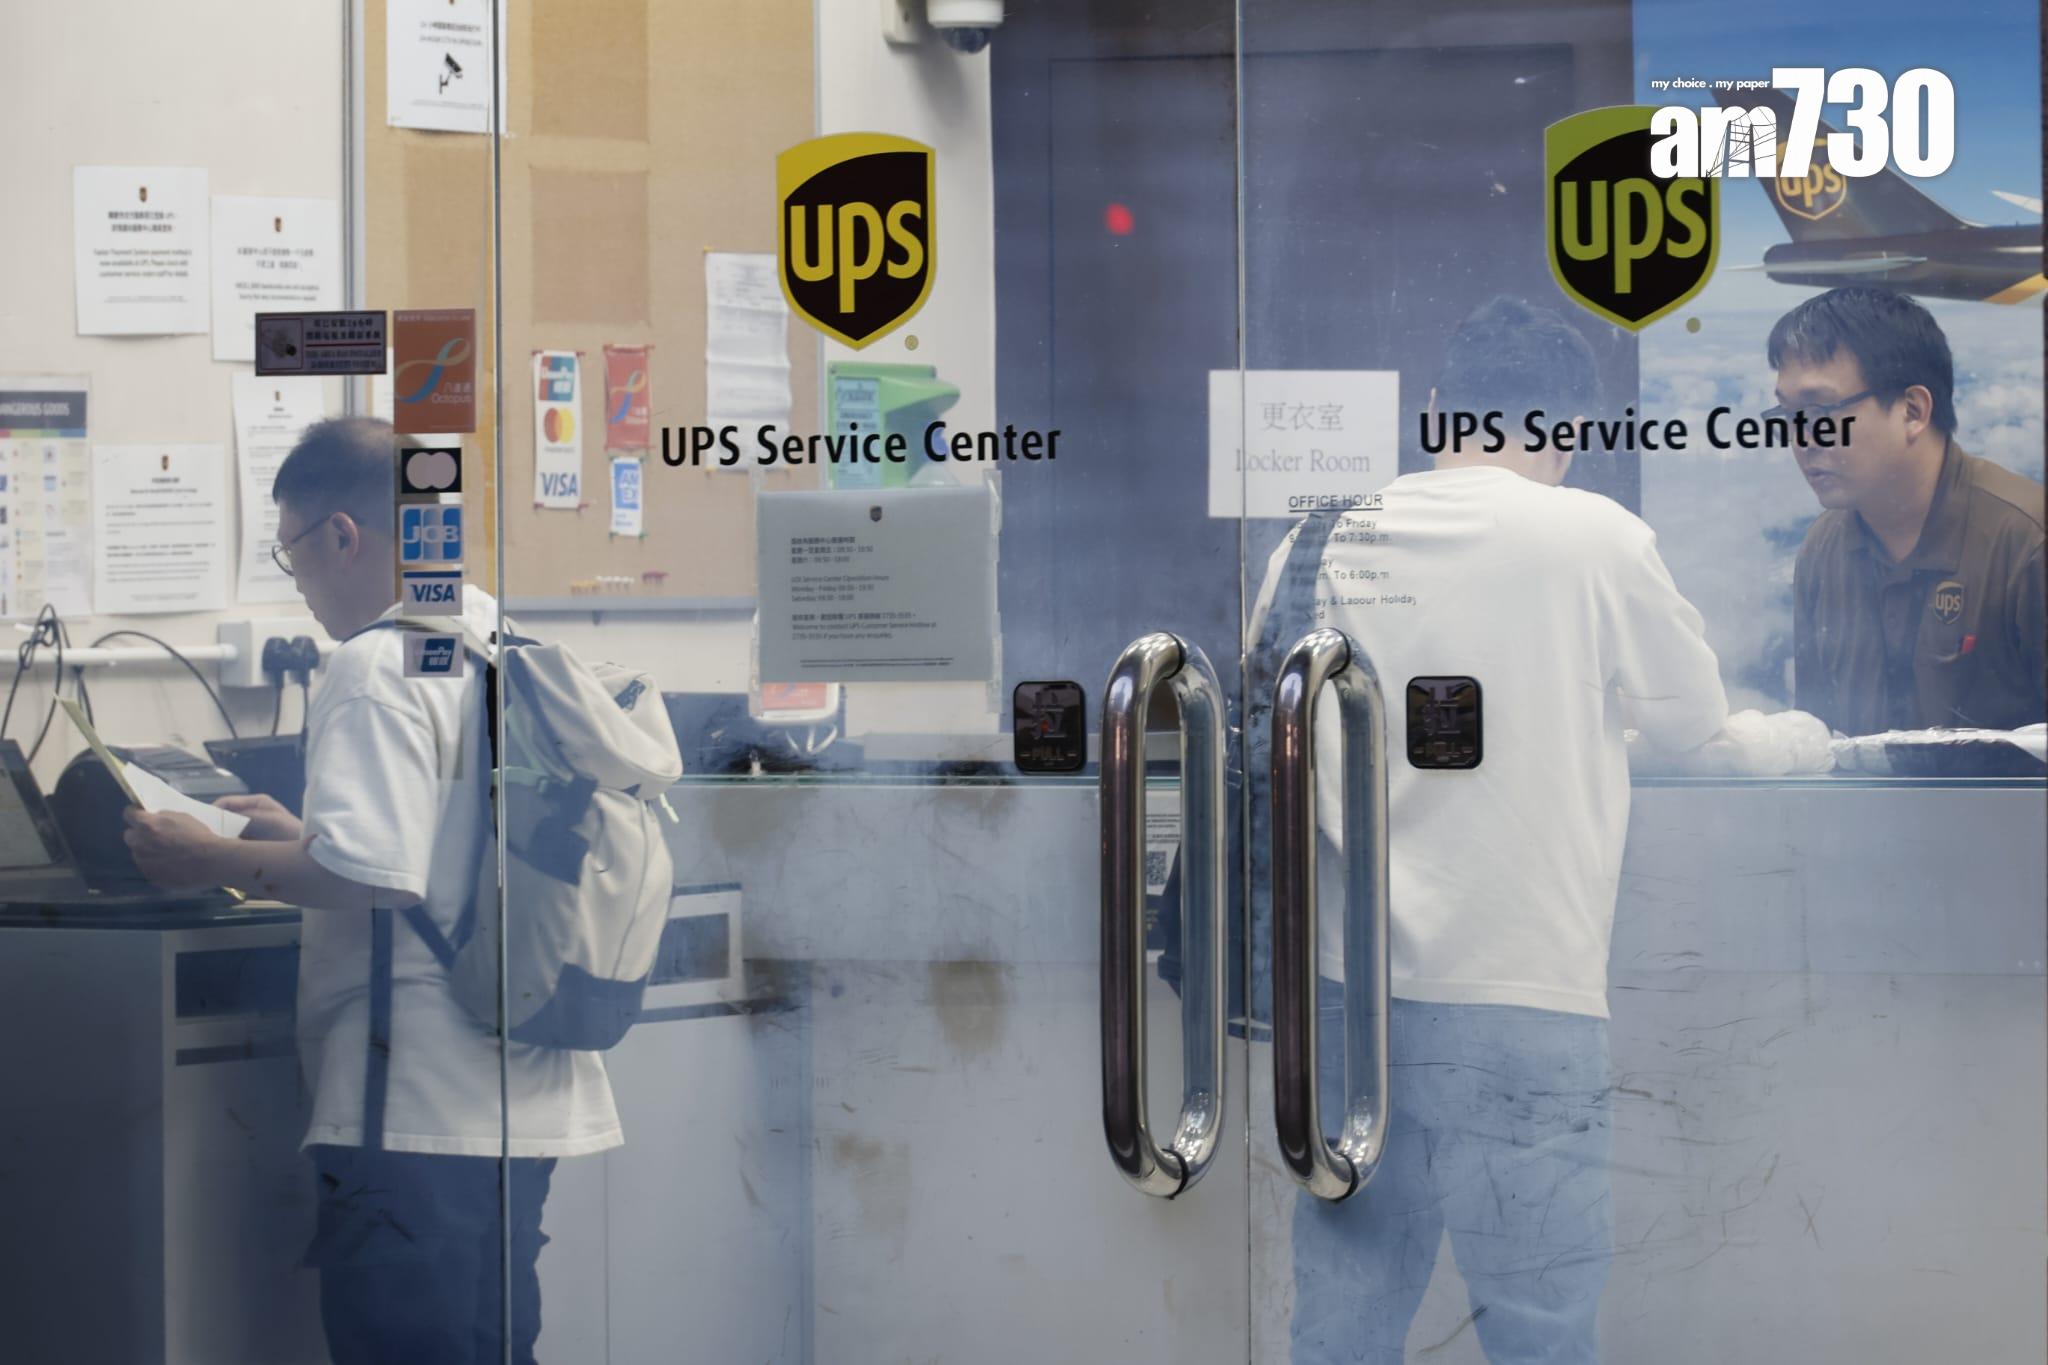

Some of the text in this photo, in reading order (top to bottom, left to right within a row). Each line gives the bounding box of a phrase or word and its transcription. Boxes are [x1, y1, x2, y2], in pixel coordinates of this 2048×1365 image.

[1781, 162, 1843, 208] ups
[1561, 178, 1707, 294] ups
[791, 200, 924, 313] ups
[1261, 401, 1344, 431] 更衣室
[1420, 406, 1856, 454] UPS Service Center
[661, 421, 1062, 467] UPS Service Center
[1235, 449, 1371, 473] Locker Room
[540, 472, 578, 497] VISA
[1288, 494, 1384, 508] OFFICE HOUR
[1334, 533, 1346, 542] To
[1334, 570, 1346, 579] To
[410, 583, 456, 602] VISA
[1936, 593, 1961, 616] ups
